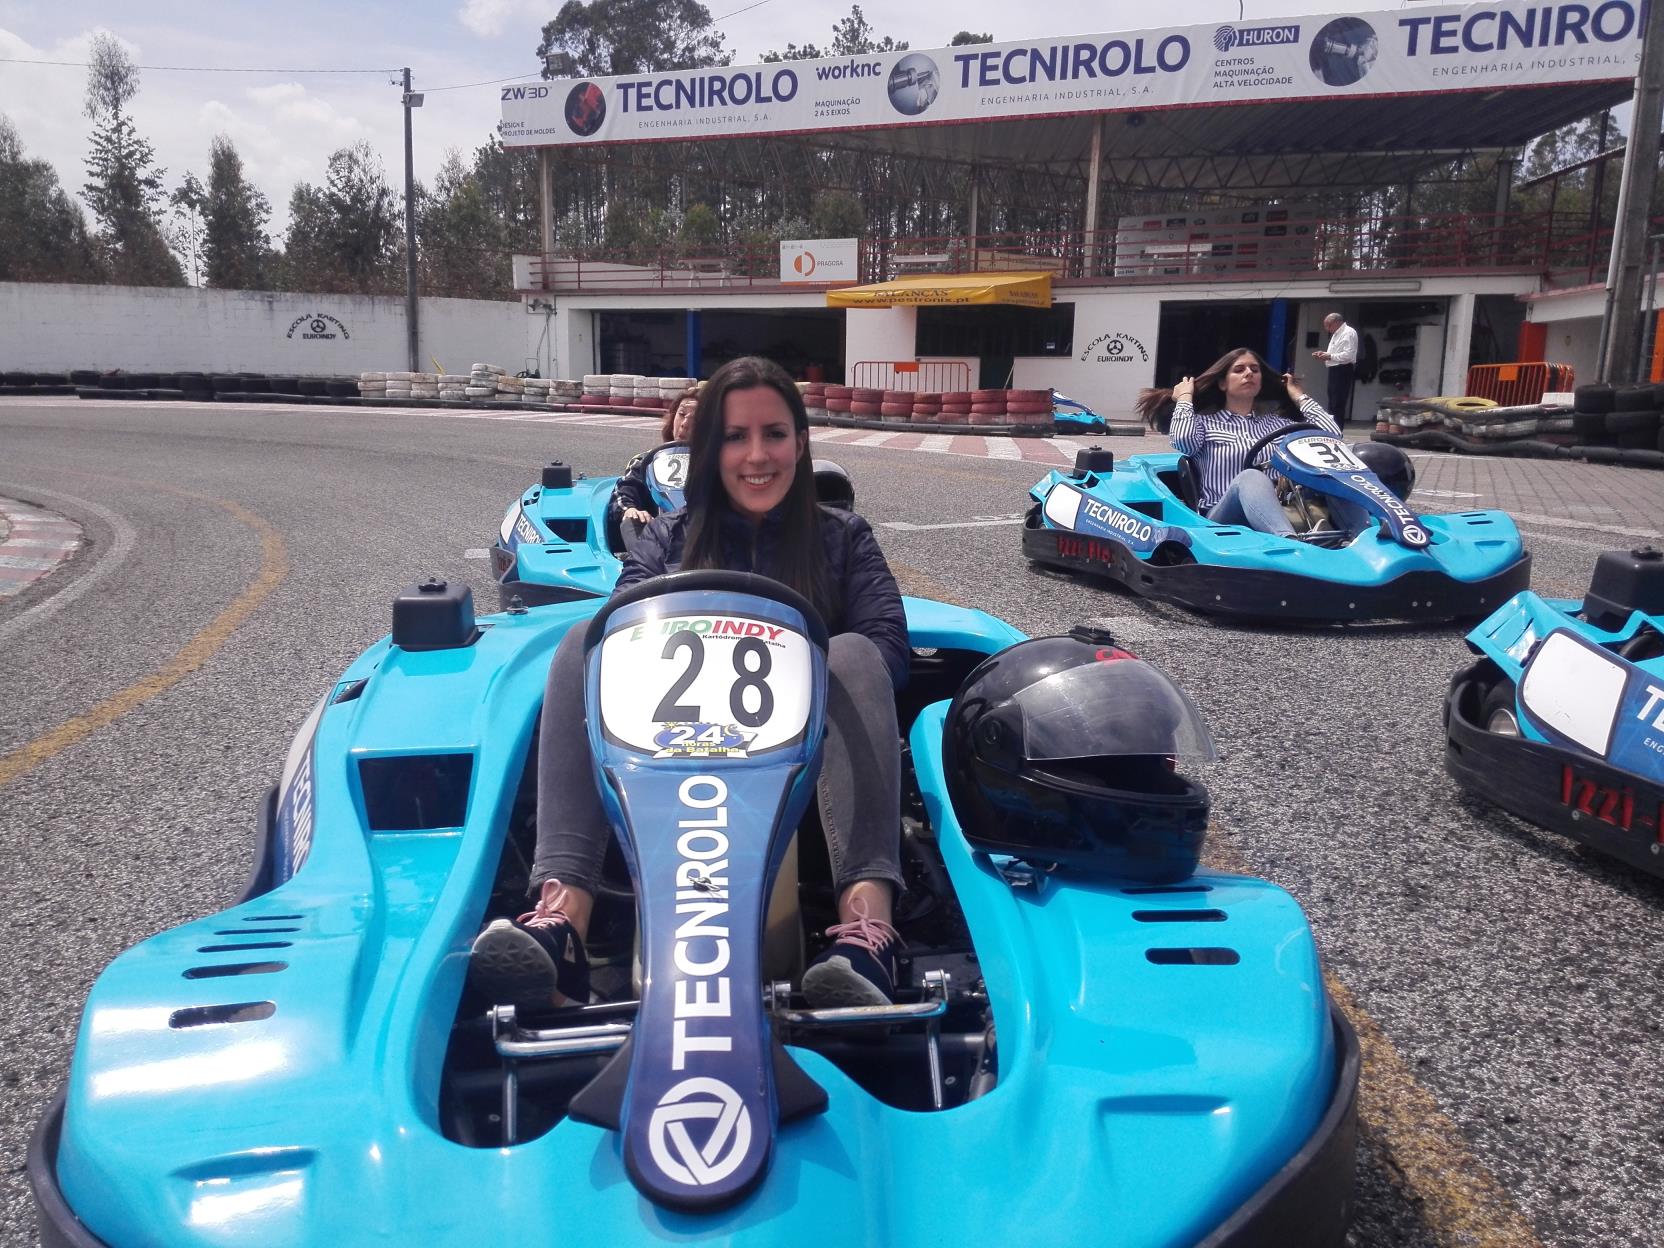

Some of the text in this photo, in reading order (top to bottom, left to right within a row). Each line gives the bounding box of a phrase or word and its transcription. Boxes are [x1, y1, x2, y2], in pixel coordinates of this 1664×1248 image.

[1243, 28, 1295, 44] HURON
[1398, 0, 1646, 57] TECNIRO
[816, 59, 882, 80] worknc
[954, 34, 1191, 88] TECNIROLO
[1214, 66, 1275, 78] MAQUINAÇÃO
[1215, 57, 1255, 67] CENTROS
[1433, 62, 1523, 77] ENGENHARIA
[1531, 54, 1626, 70] INDUSTRIAL,
[616, 69, 799, 113] TECNIROLO
[1213, 76, 1293, 89] ALTA VELOCIDADE
[815, 97, 861, 108] MAQUINAÇÃO
[981, 93, 1049, 106] ENGENHARIA
[1132, 86, 1155, 95] S.A.
[639, 119, 692, 129] ENGENHARIA
[754, 113, 772, 122] S.A.
[831, 108, 851, 116] EIXOS
[287, 312, 350, 340] ESCOLA KARTING
[1081, 332, 1149, 362] ESCOLA KARTING
[1309, 442, 1355, 466] 31
[1350, 475, 1415, 525] TECNIROLO
[1083, 499, 1152, 542] TECNIROLO
[652, 630, 774, 728] 28
[669, 725, 725, 746] 24
[686, 746, 739, 754] Batalha
[671, 774, 732, 1072] TECNIROLO
